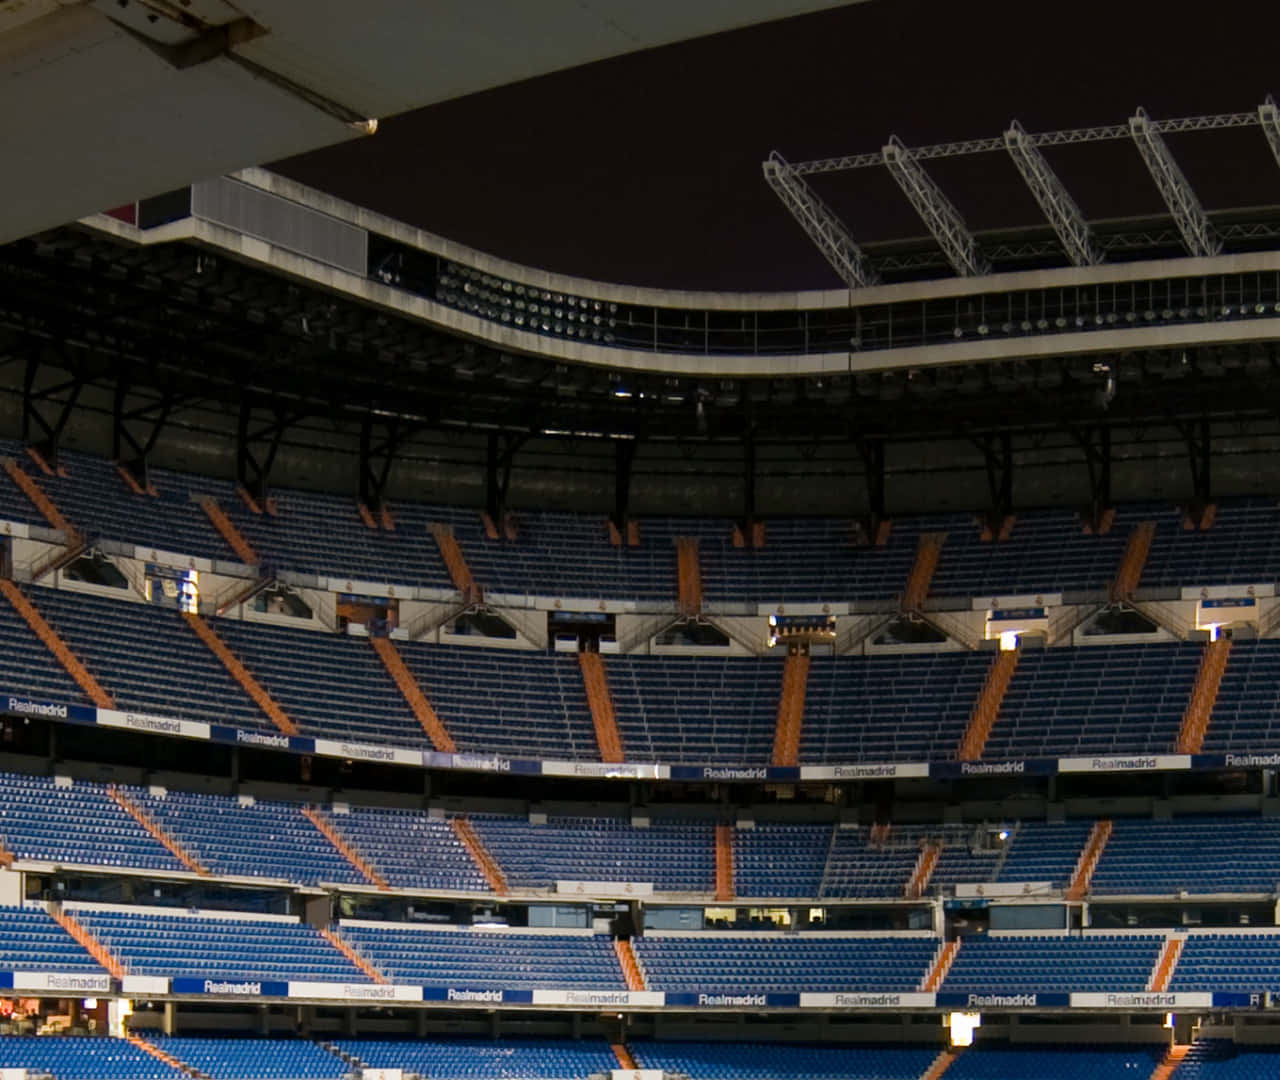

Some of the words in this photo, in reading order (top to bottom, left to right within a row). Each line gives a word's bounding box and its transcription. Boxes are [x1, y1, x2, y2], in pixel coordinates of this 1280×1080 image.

[9, 698, 67, 717] Realmadrid
[126, 715, 181, 733] Realmadrid
[237, 730, 289, 747] Realmadrid
[341, 744, 394, 760] Realmadrid
[961, 761, 1024, 774] Realmadrid
[1092, 758, 1157, 770] Realmadrid
[704, 767, 767, 779] Realmadrid
[834, 766, 896, 777] Realmadrid
[47, 976, 107, 989] Realmadrid
[204, 980, 261, 994] Realmadrid
[448, 989, 503, 1002] Realmadrid
[566, 993, 629, 1004] Realmadrid
[699, 993, 766, 1005] Realmadrid
[836, 994, 900, 1005] Realmadrid
[968, 994, 1037, 1006] Realmadrid
[1107, 994, 1176, 1006] Realmadrid
